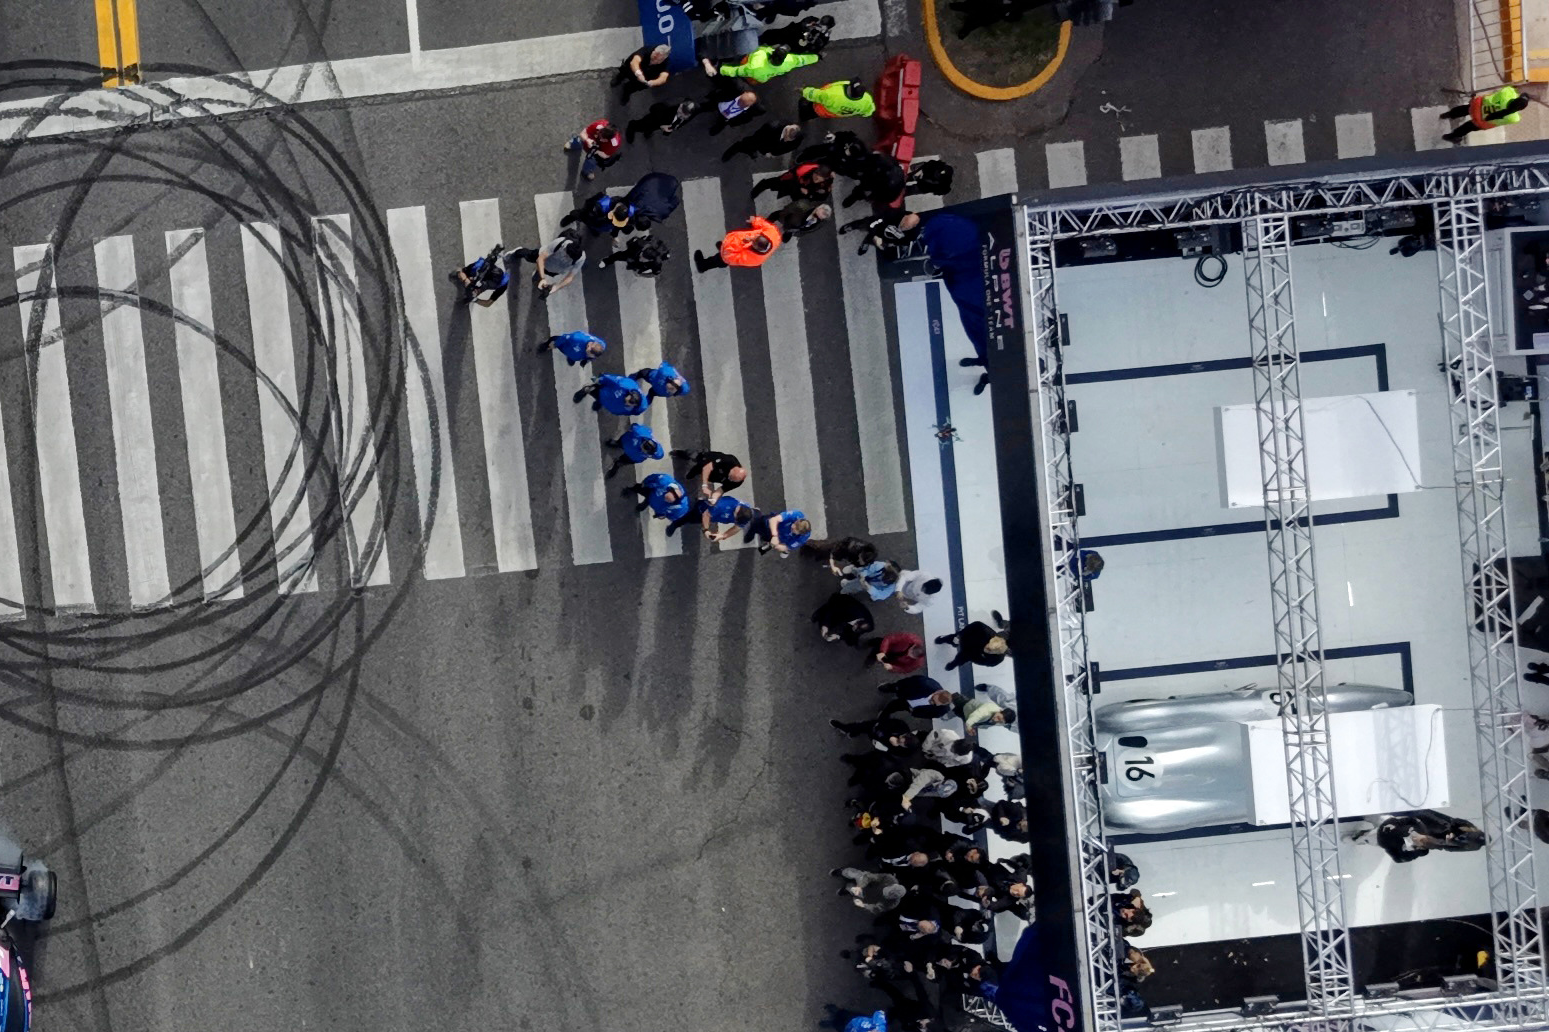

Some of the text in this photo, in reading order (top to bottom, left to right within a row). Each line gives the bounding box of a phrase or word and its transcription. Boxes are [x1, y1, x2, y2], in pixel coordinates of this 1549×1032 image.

[988, 232, 1004, 350] ALPINE
[1001, 273, 1014, 329] BWT
[1124, 756, 1155, 781] 16
